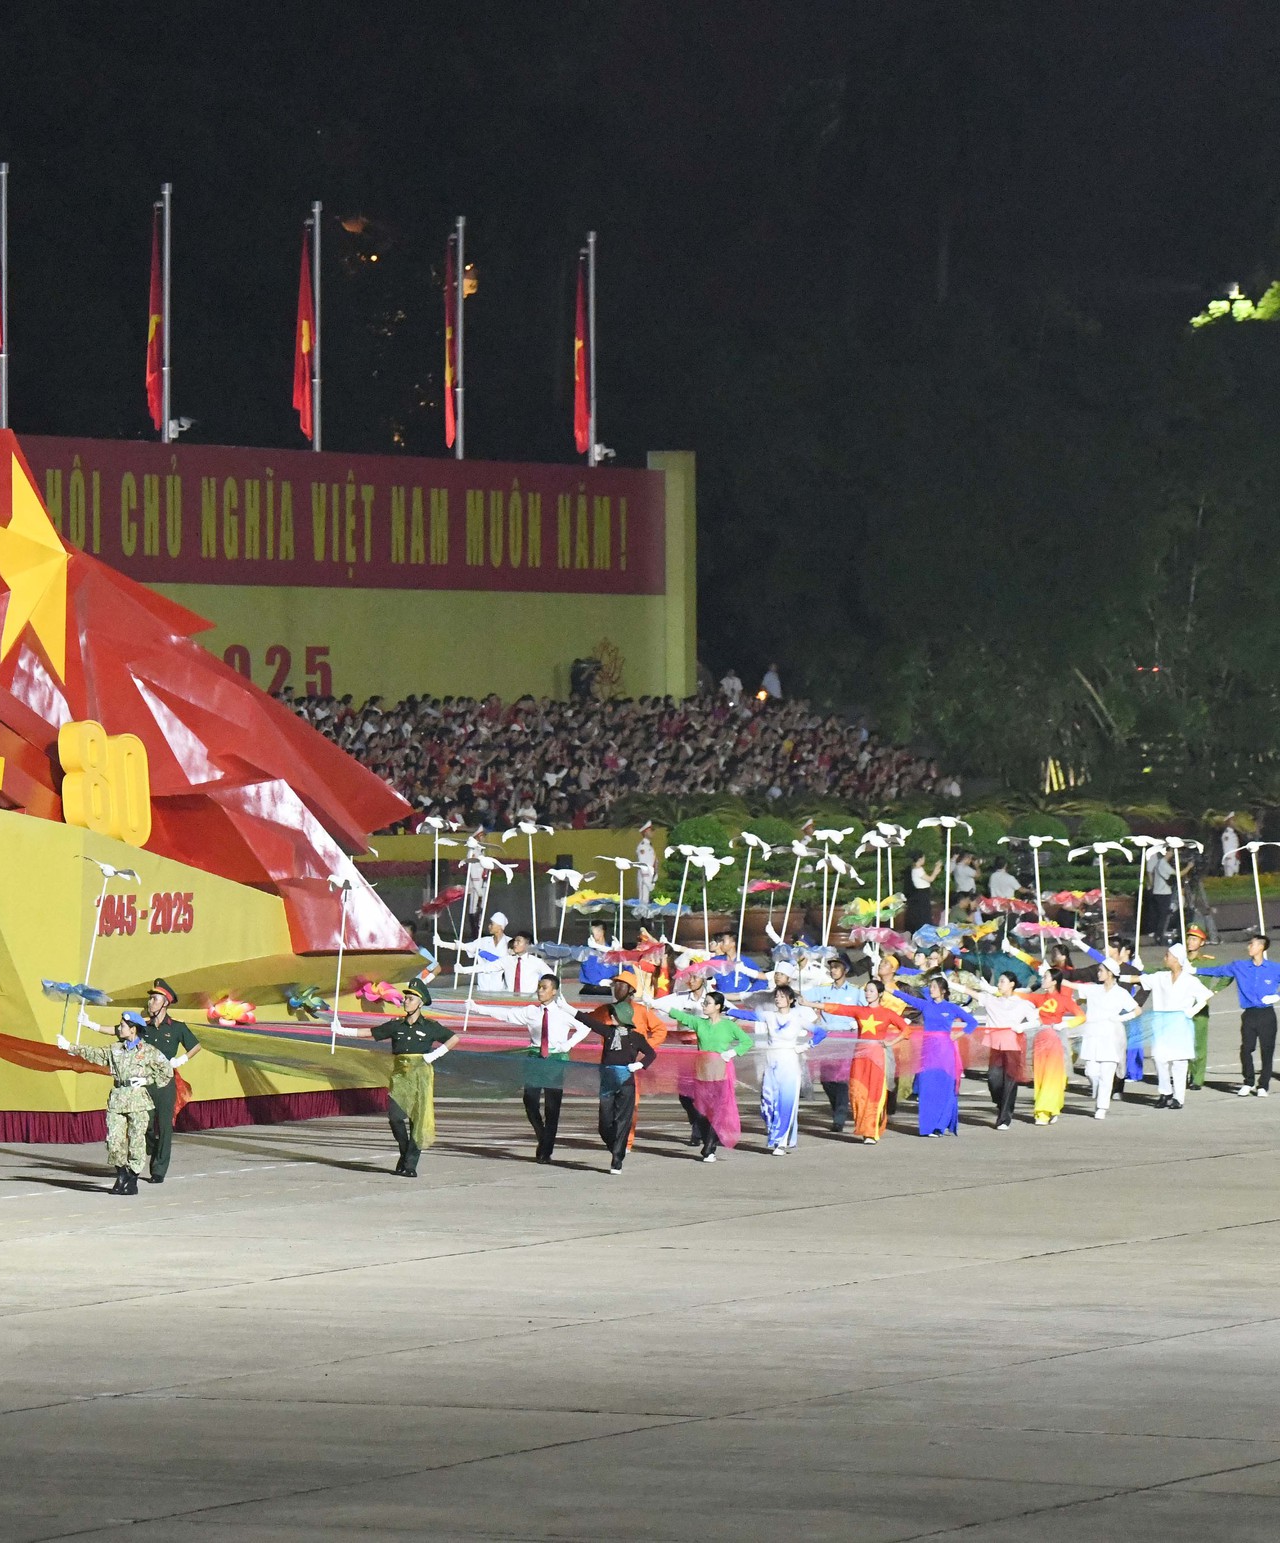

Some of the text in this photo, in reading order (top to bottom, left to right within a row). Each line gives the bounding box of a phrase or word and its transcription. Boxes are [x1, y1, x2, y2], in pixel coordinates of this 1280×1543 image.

[121, 454, 182, 558] CHỦ
[201, 466, 295, 560] NGHĨA
[311, 469, 374, 579] VIỆT
[391, 486, 449, 565] NAM
[466, 478, 542, 568] MUÔN
[223, 644, 332, 697] 025
[58, 719, 152, 848] 80
